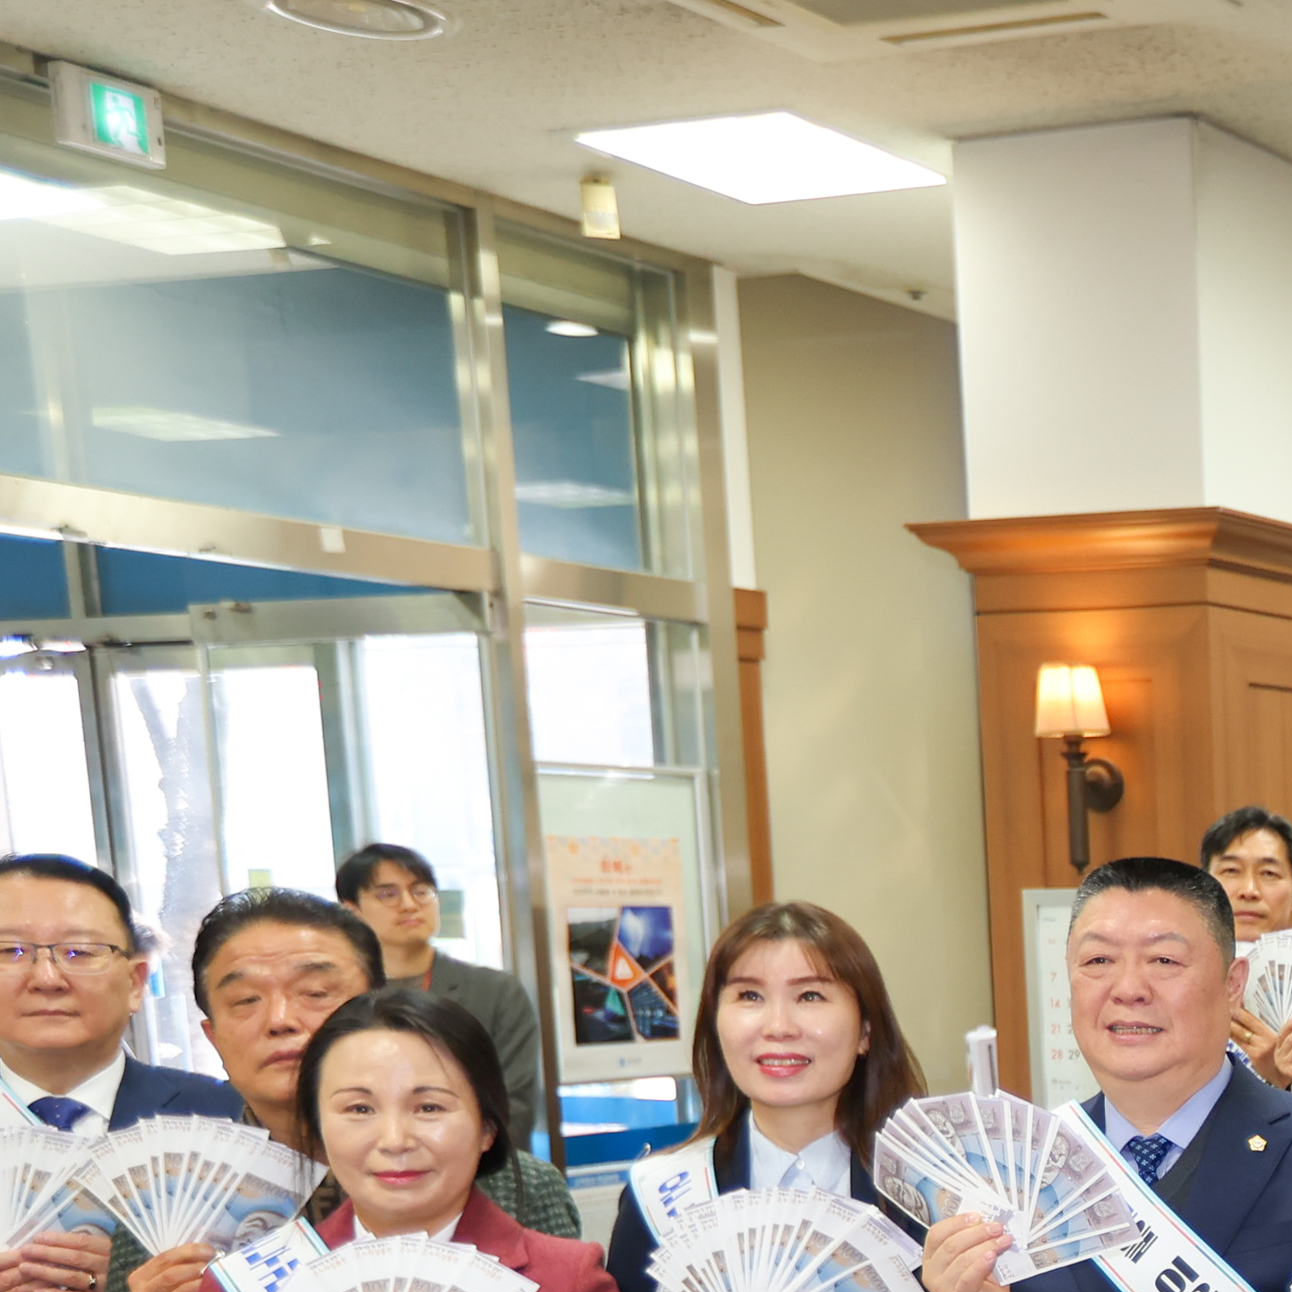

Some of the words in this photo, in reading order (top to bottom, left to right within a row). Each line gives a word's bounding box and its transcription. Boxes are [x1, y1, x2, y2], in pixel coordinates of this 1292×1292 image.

[1051, 1024, 1062, 1035] 21
[1052, 1049, 1063, 1060] 28
[1068, 1049, 1080, 1060] 29
